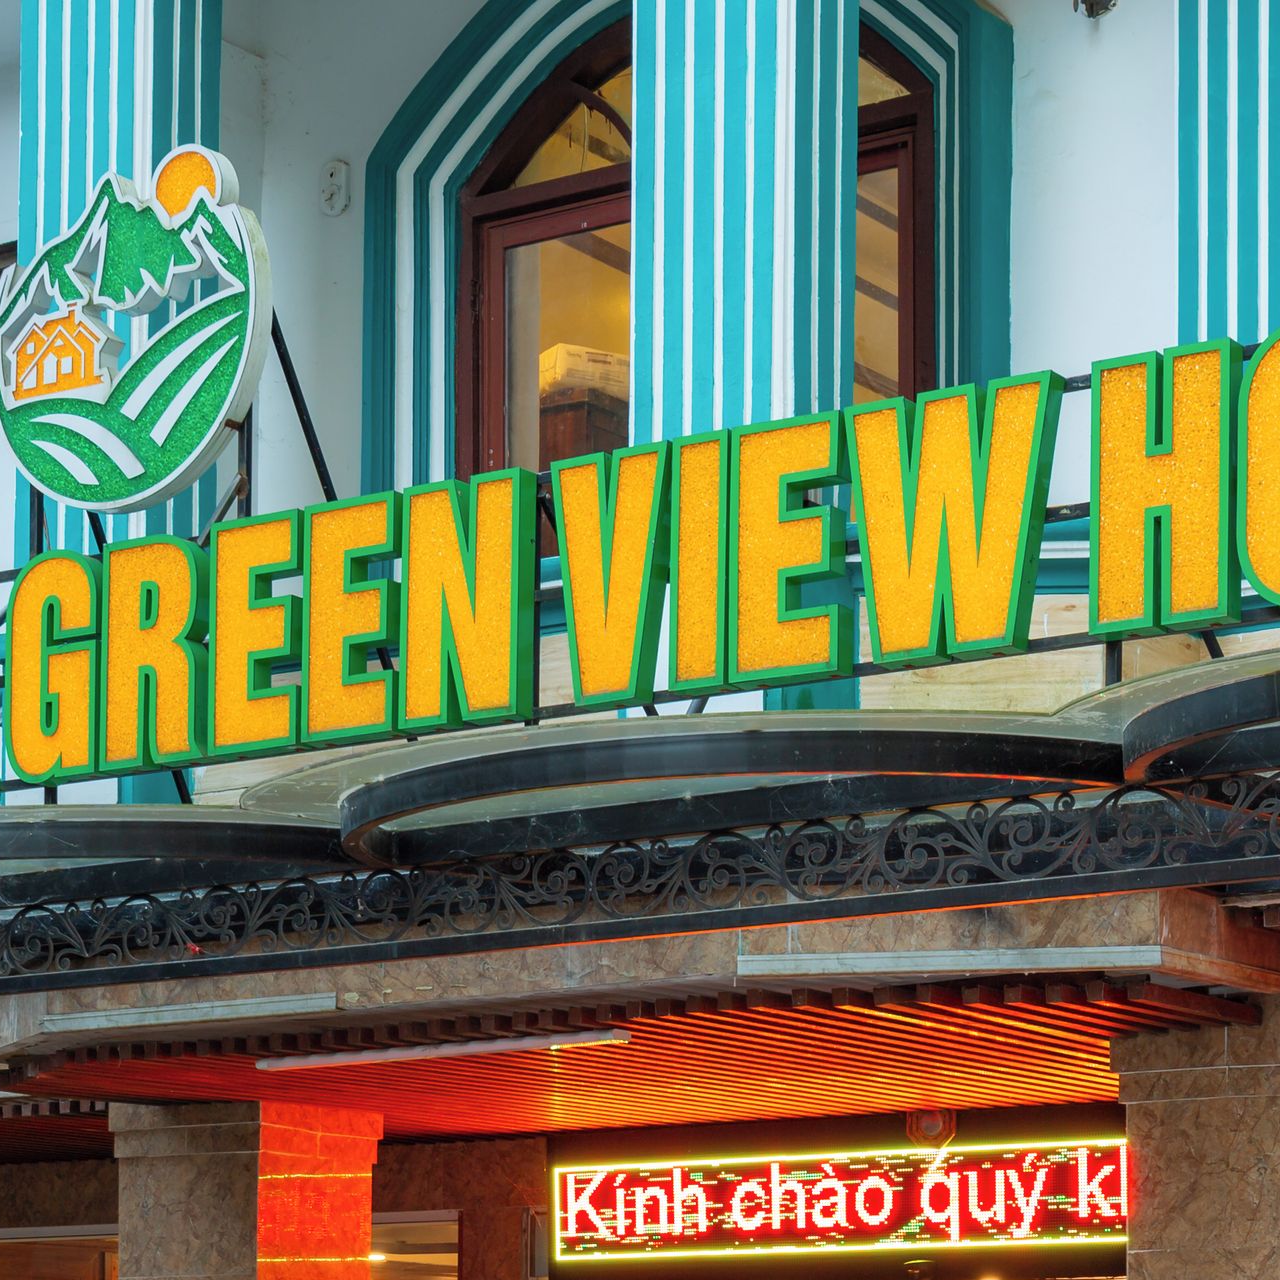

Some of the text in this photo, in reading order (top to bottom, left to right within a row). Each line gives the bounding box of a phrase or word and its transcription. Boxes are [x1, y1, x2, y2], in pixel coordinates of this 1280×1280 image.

[3, 467, 535, 784] GREEN
[549, 370, 1066, 708] VIEW
[563, 1168, 708, 1238] Kính
[731, 1161, 896, 1231] chào
[920, 1151, 1049, 1243] quý
